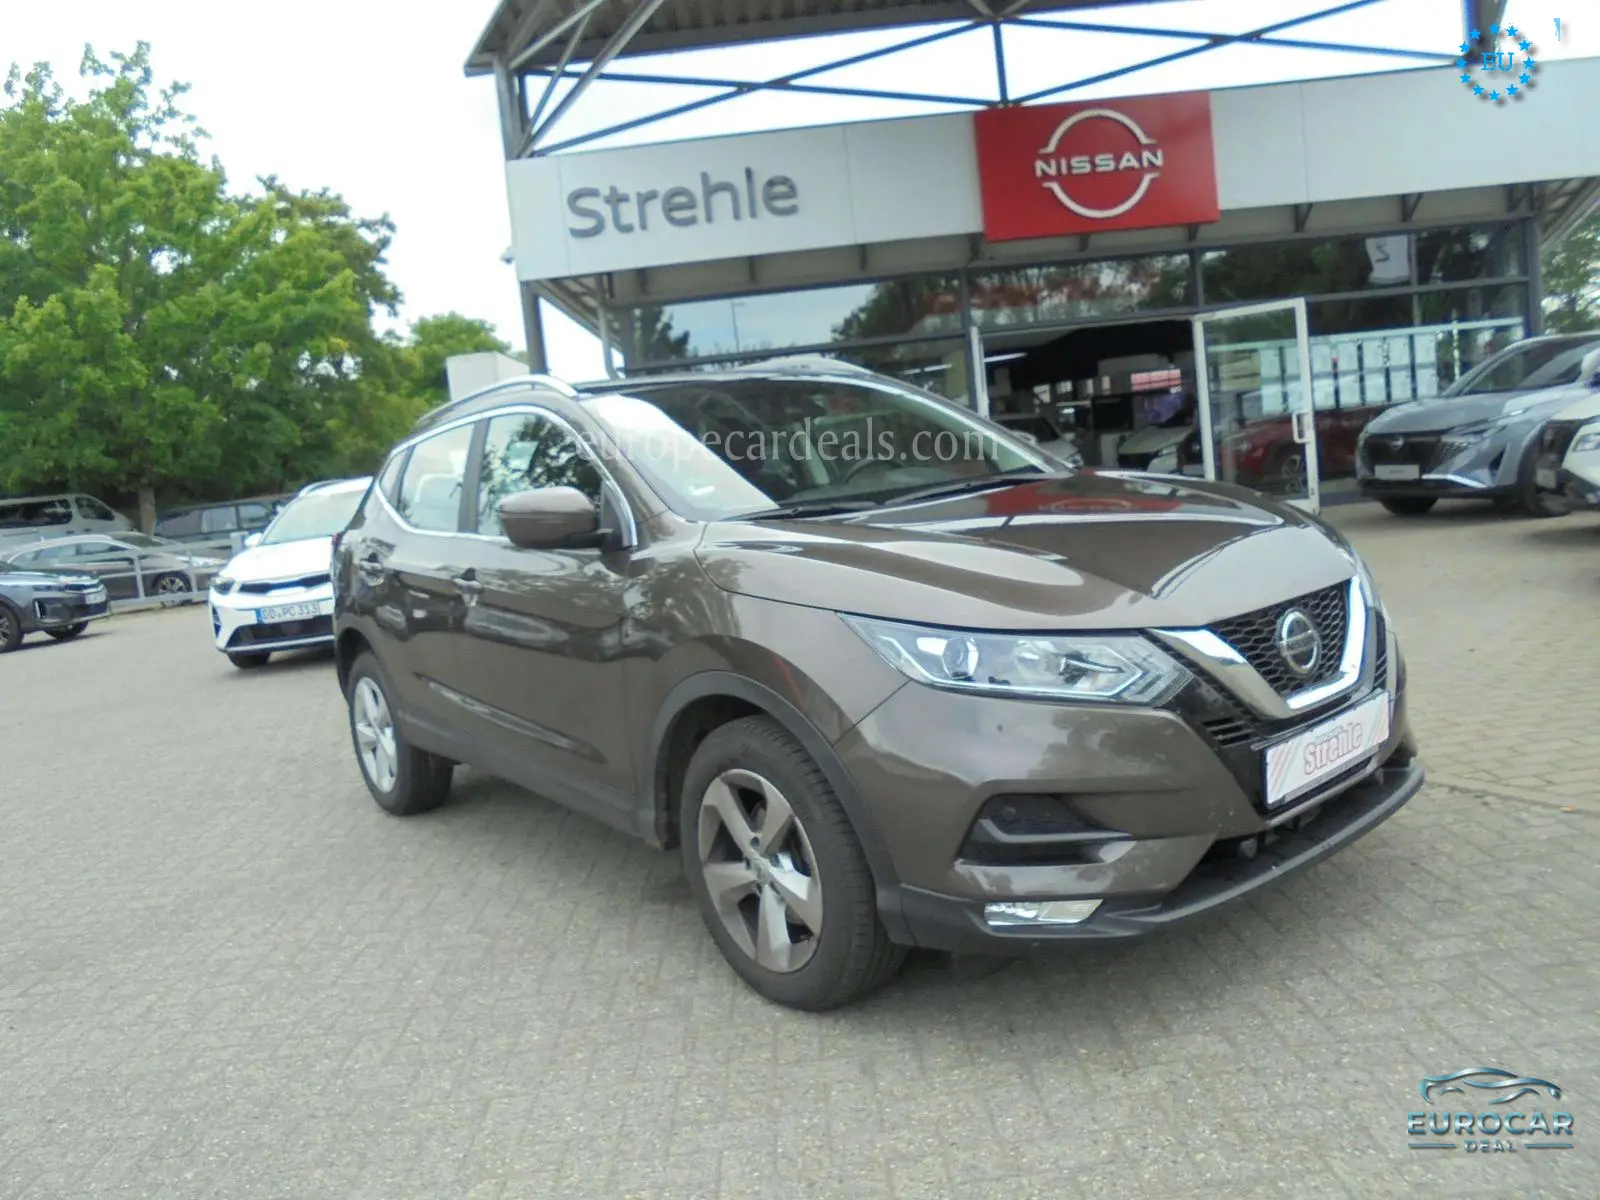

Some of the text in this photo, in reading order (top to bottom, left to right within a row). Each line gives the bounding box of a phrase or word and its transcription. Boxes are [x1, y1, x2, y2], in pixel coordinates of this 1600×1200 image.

[1034, 148, 1163, 178] NISSAN
[566, 166, 799, 239] Strehle
[1303, 722, 1362, 775] Strehle
